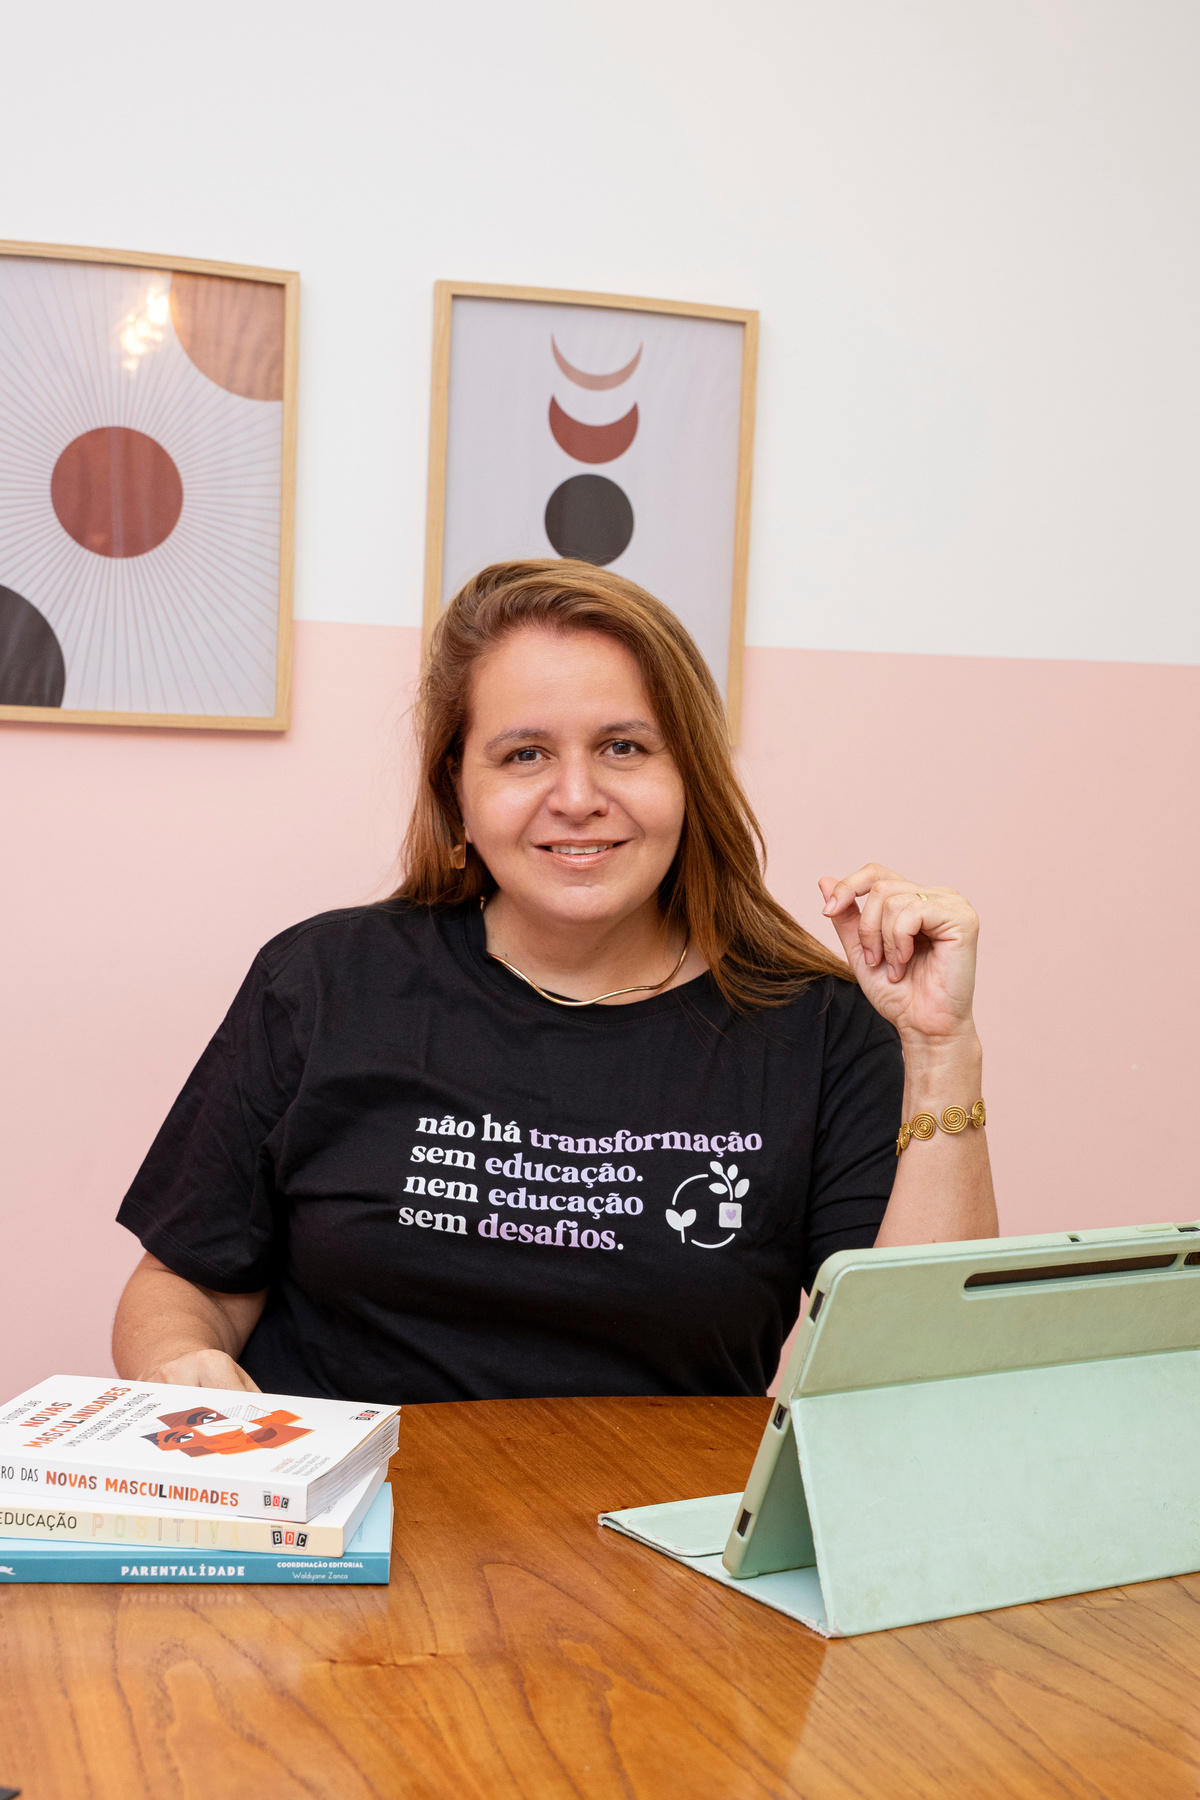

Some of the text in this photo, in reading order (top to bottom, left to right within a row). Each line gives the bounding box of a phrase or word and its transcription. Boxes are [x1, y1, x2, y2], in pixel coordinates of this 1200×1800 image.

[415, 1114, 763, 1157] não há transformação
[410, 1145, 644, 1188] sem educação.
[403, 1175, 644, 1219] nem educação
[398, 1206, 624, 1251] sem desafios.
[19, 1401, 73, 1428] NOVAS
[22, 1386, 132, 1449] MASCULINIDADES
[20, 1467, 39, 1482] DAS
[46, 1470, 97, 1490] NOVAS
[105, 1477, 239, 1507] MASCULINIDADES
[264, 1494, 289, 1509] BOC
[91, 1513, 240, 1546] POSITIVA
[272, 1530, 308, 1549] BOC
[276, 1561, 364, 1569] COORDENAÇÃO EDITORIAL
[327, 1571, 349, 1580] Zanca
